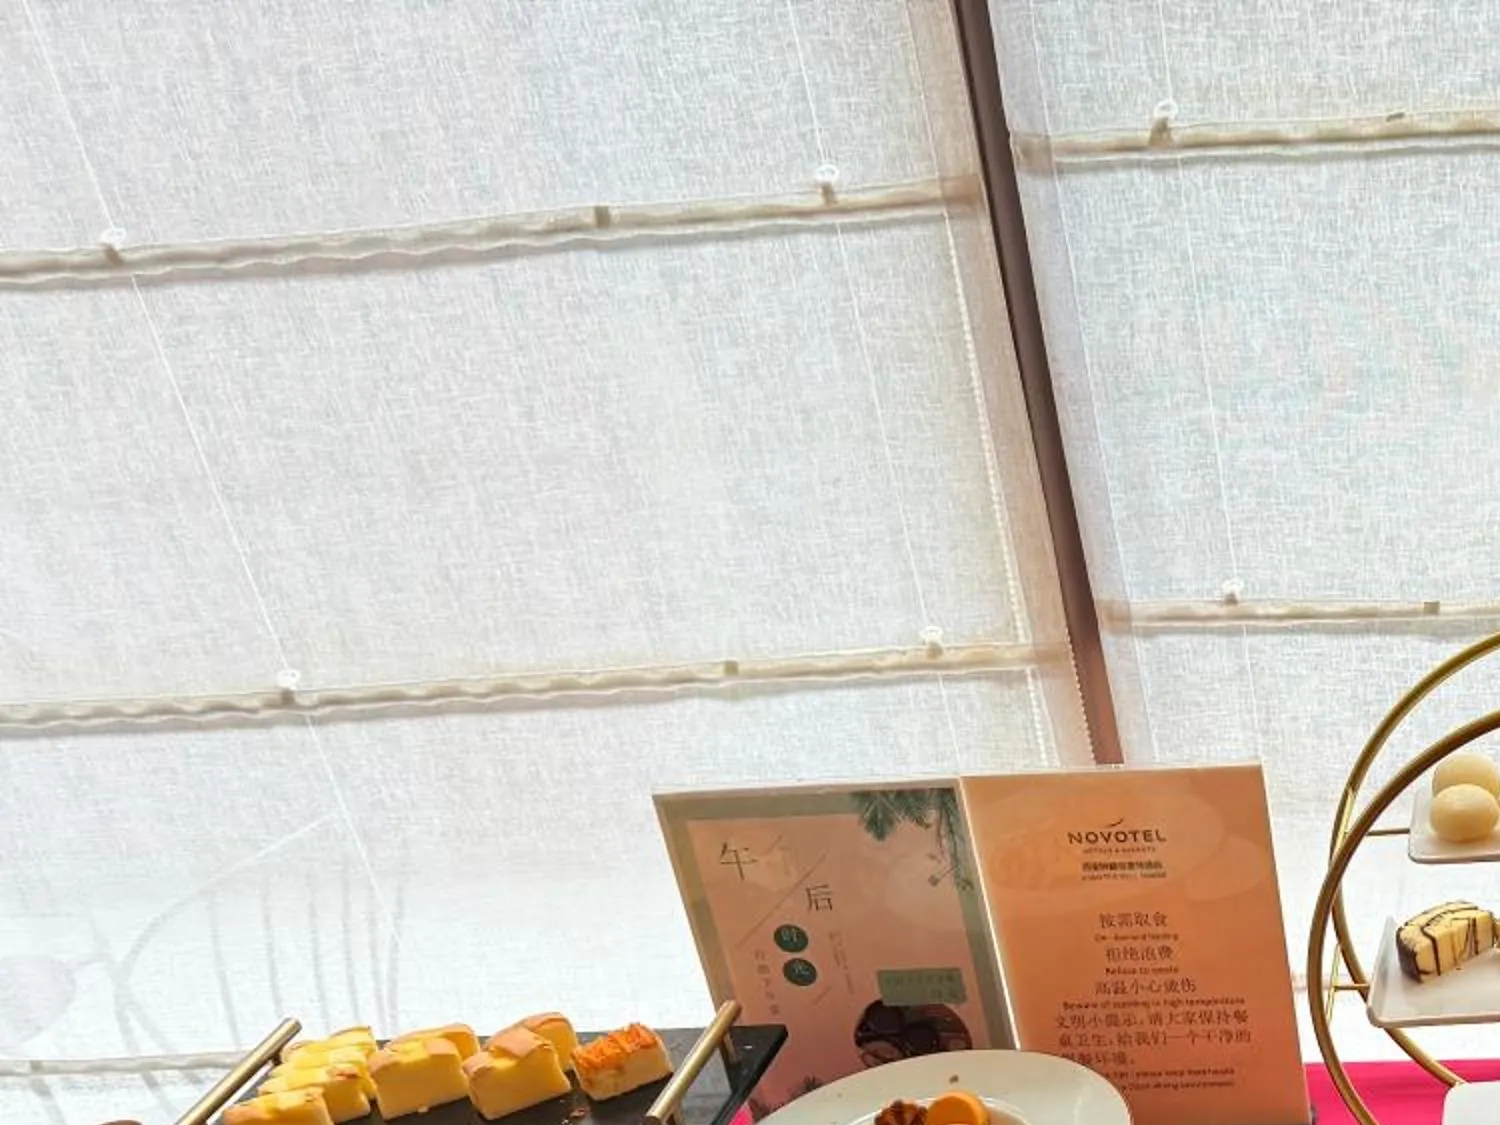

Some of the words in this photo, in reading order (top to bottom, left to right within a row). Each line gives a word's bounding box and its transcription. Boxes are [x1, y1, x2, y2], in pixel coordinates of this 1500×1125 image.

[1067, 829, 1167, 845] NOVOTEL
[720, 841, 759, 882] 午
[805, 884, 834, 914] 后
[1099, 911, 1169, 929] 按需取食
[1105, 945, 1174, 963] 拒绝浪费
